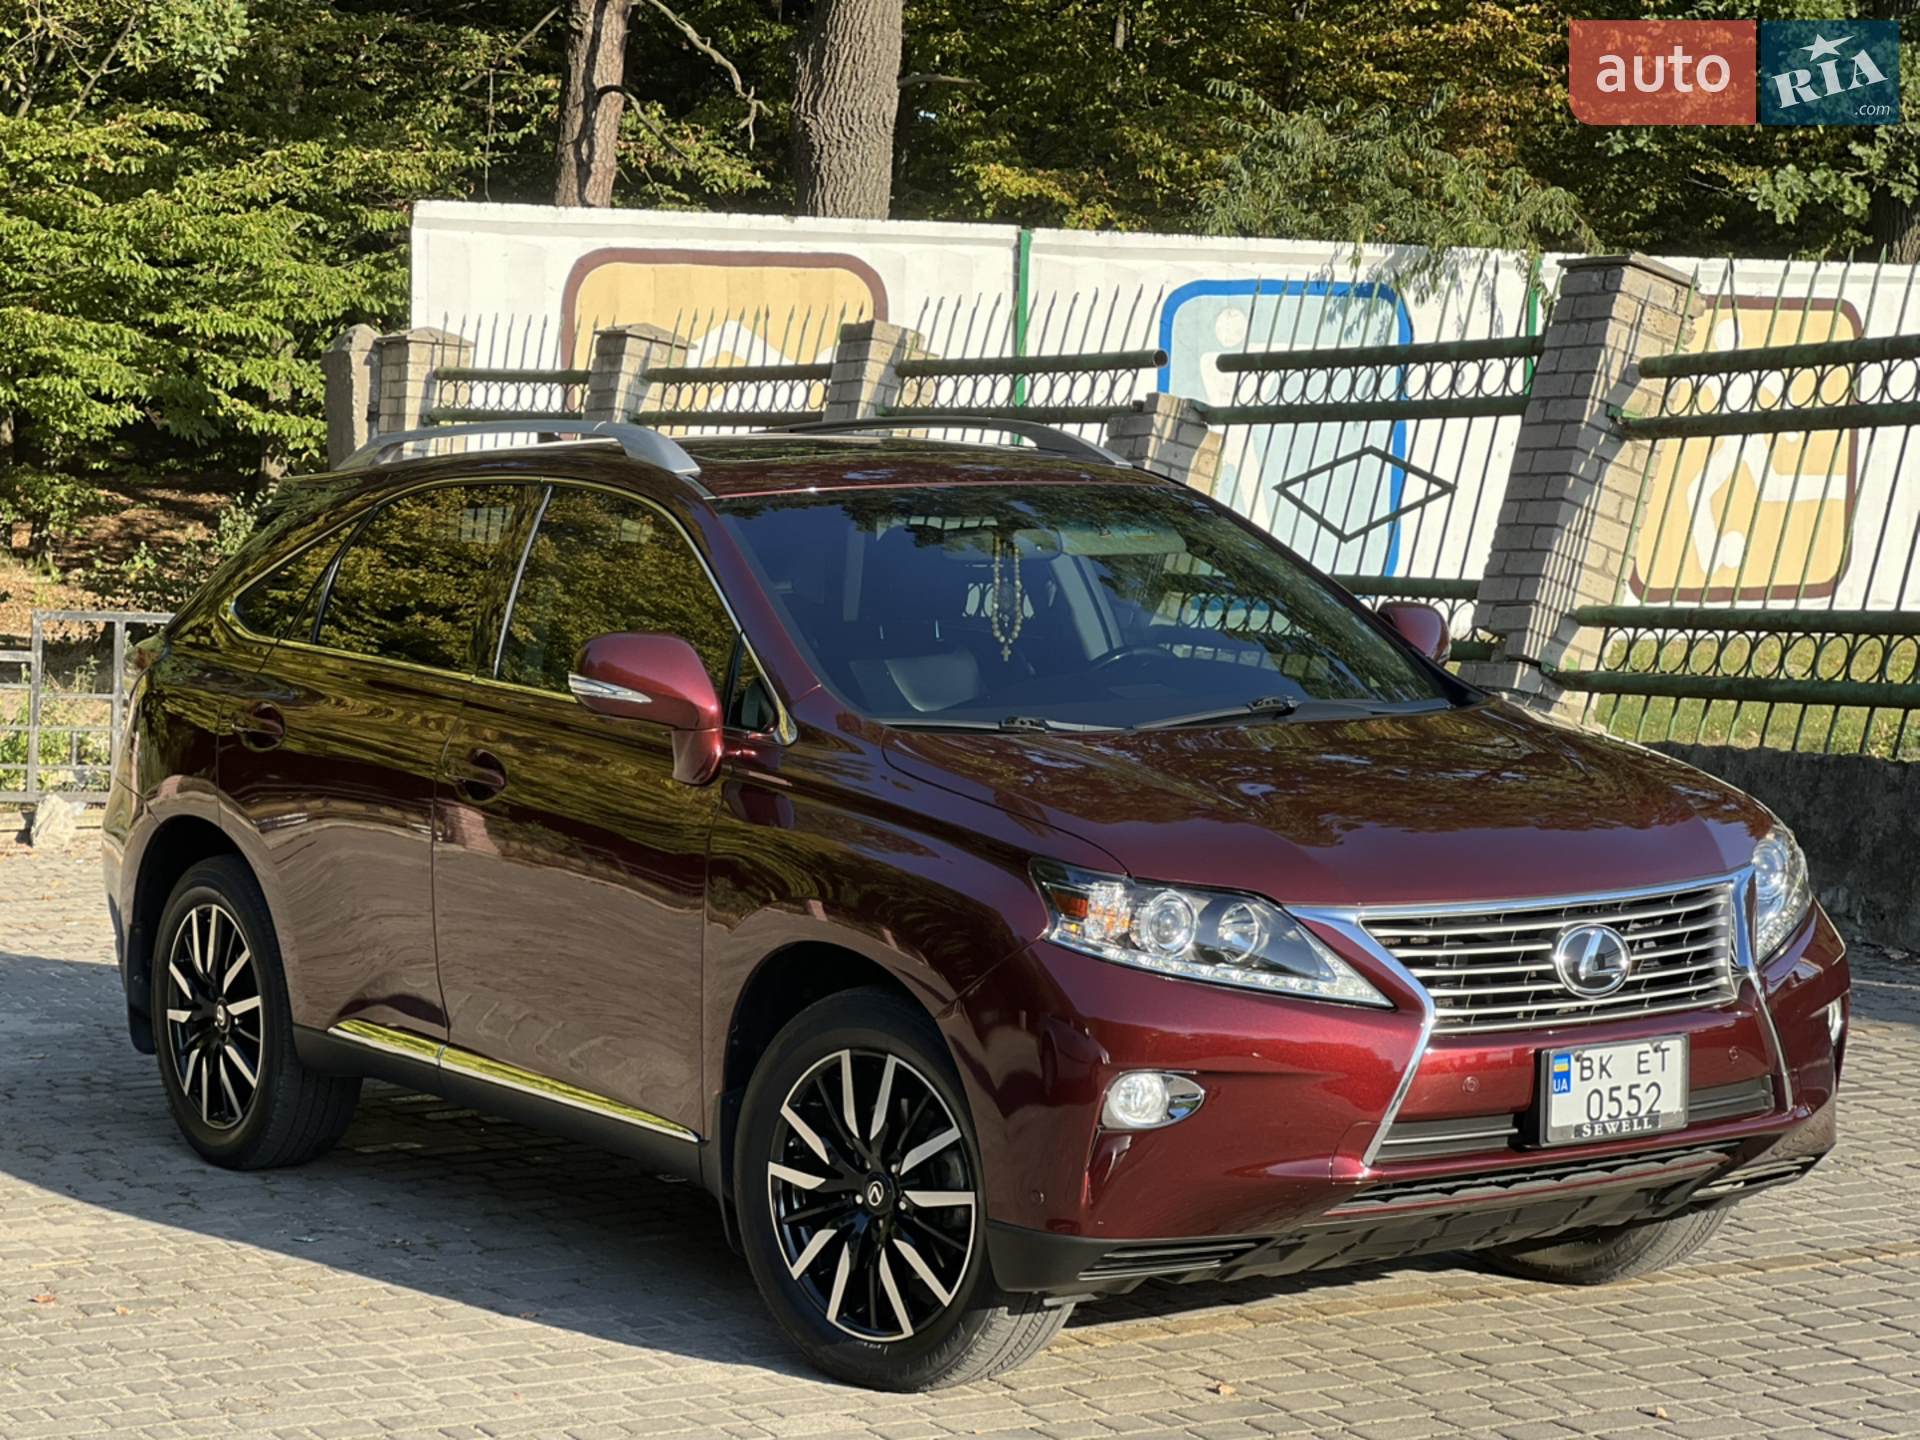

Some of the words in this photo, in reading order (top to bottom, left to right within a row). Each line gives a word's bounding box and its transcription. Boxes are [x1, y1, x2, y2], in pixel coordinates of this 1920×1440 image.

[1579, 1054, 1613, 1082] BK
[1637, 1047, 1671, 1075] ET
[1553, 1078, 1569, 1092] UA
[1586, 1081, 1662, 1123] 0552
[1581, 1118, 1652, 1138] SEWELL
